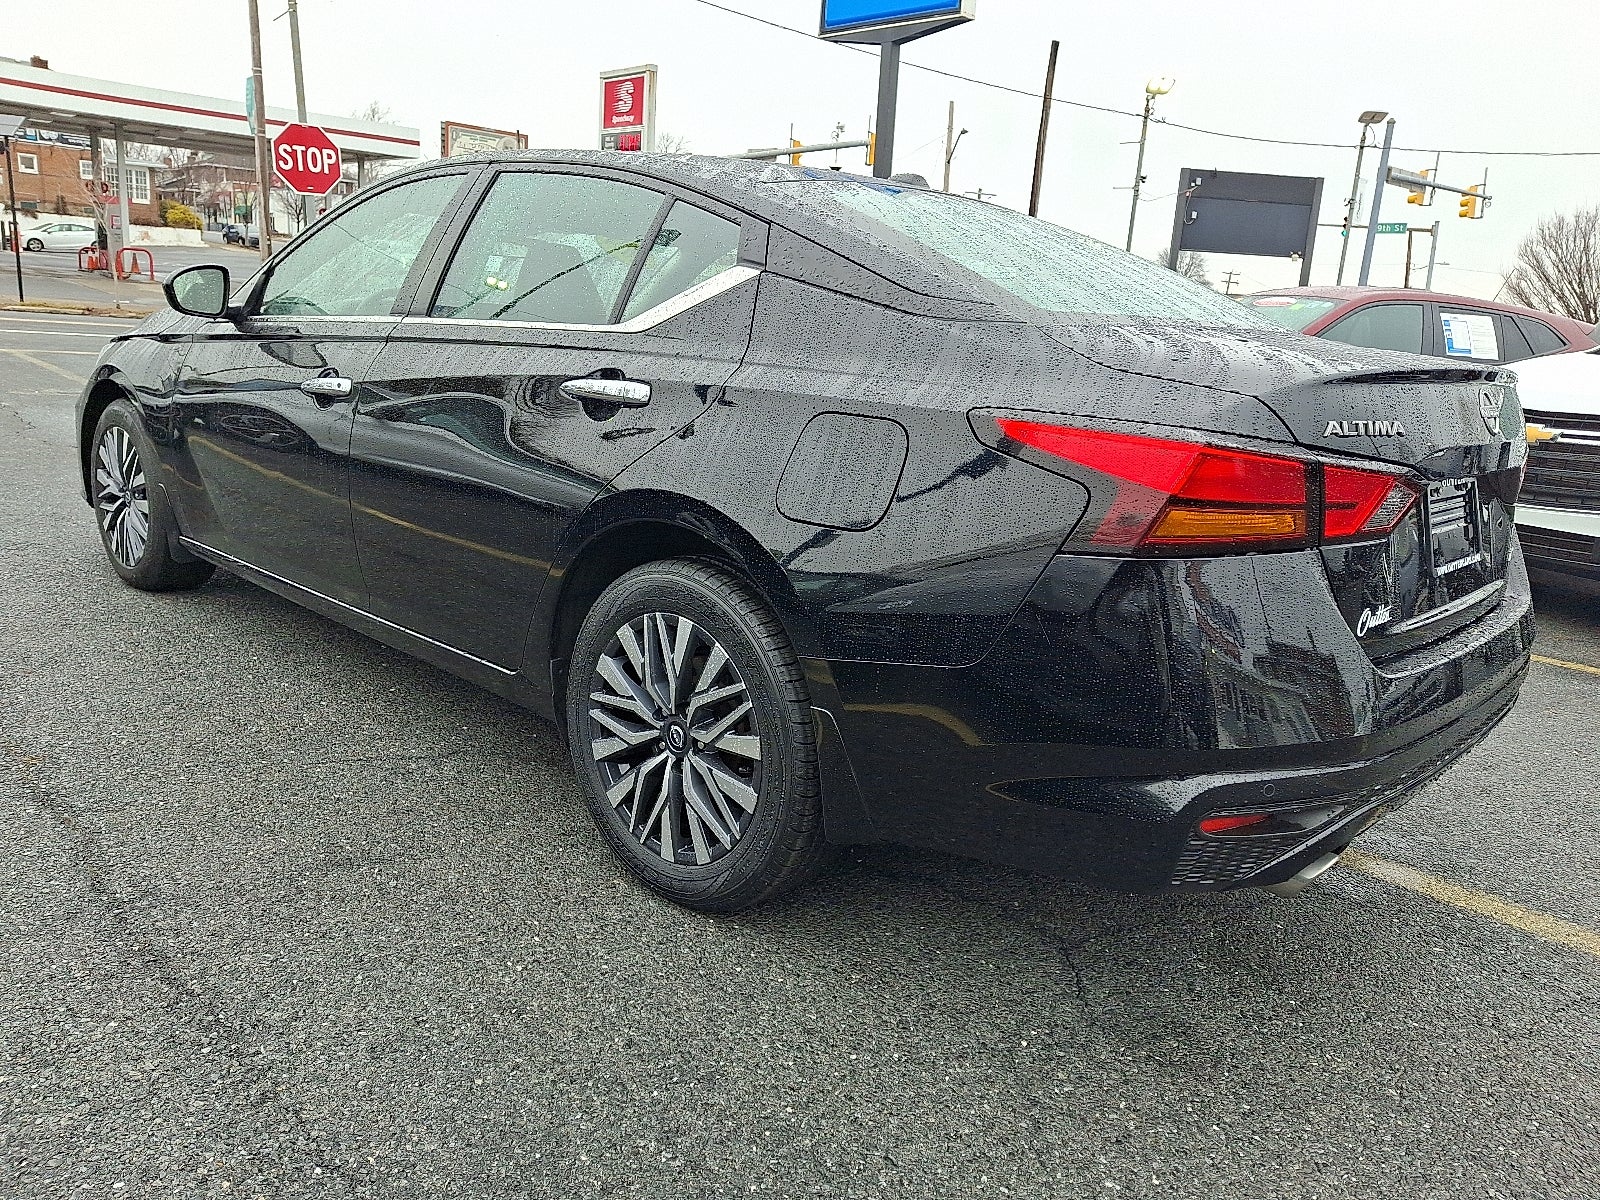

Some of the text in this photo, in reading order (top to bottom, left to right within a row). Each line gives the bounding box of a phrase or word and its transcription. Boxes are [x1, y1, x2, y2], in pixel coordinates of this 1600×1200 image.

[278, 143, 337, 175] STOP
[1377, 224, 1404, 232] 9th St
[1322, 420, 1406, 437] ALTIMA
